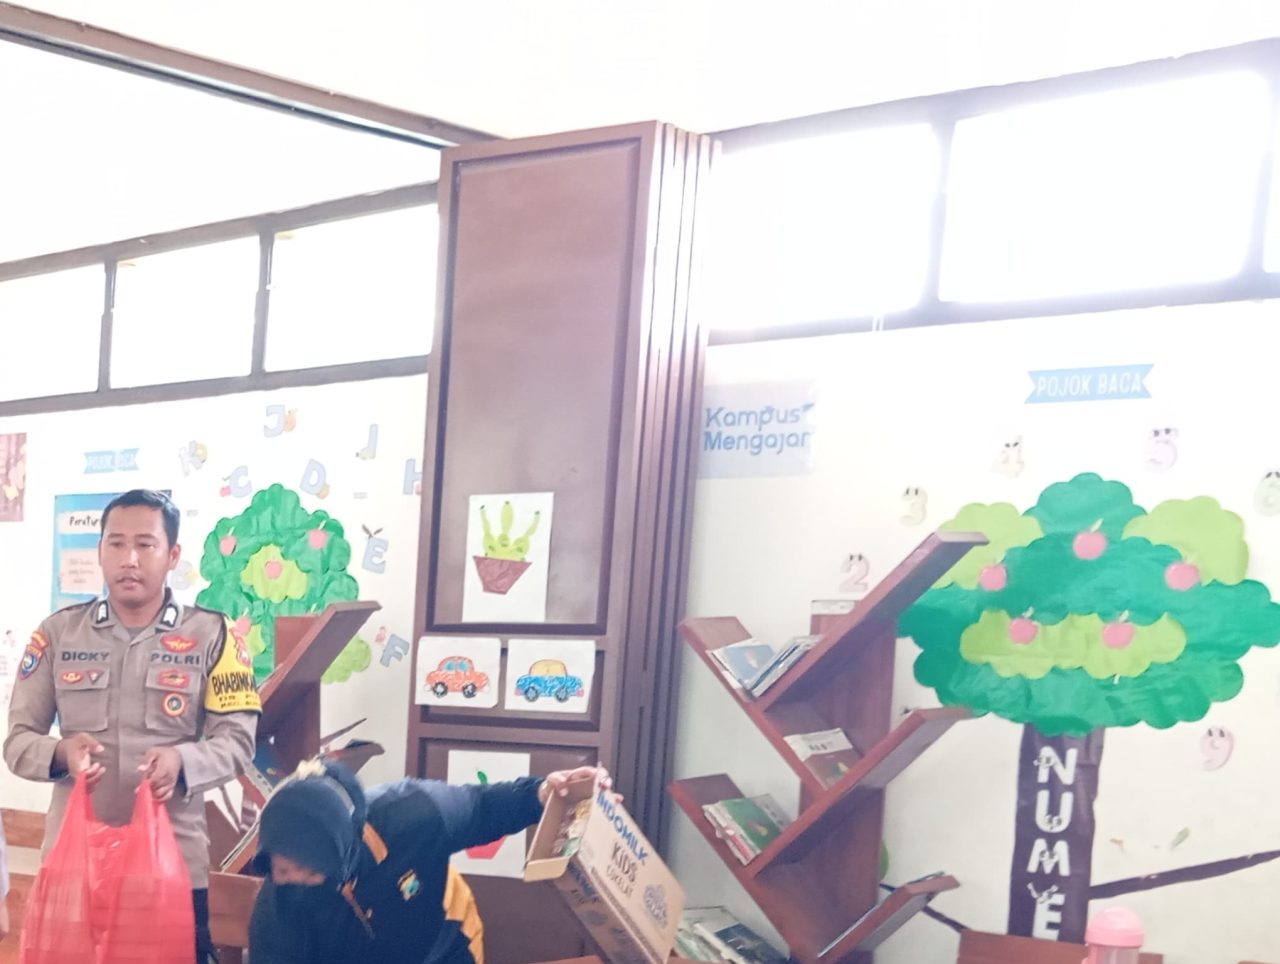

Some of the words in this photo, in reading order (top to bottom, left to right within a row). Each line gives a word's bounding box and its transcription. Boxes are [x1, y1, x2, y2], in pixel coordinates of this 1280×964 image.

[1036, 374, 1091, 397] POJOK
[1098, 371, 1142, 395] BACA
[705, 406, 801, 432] Kampus
[704, 431, 814, 456] Mengajar
[1145, 427, 1179, 474] 5
[230, 465, 252, 498] C
[299, 458, 327, 496] D
[899, 485, 928, 527] 3
[361, 537, 389, 574] E
[839, 553, 870, 593] 2
[62, 651, 109, 662] DICKY
[151, 653, 200, 665] POLRI
[380, 633, 410, 668] F
[1200, 725, 1235, 772] 9
